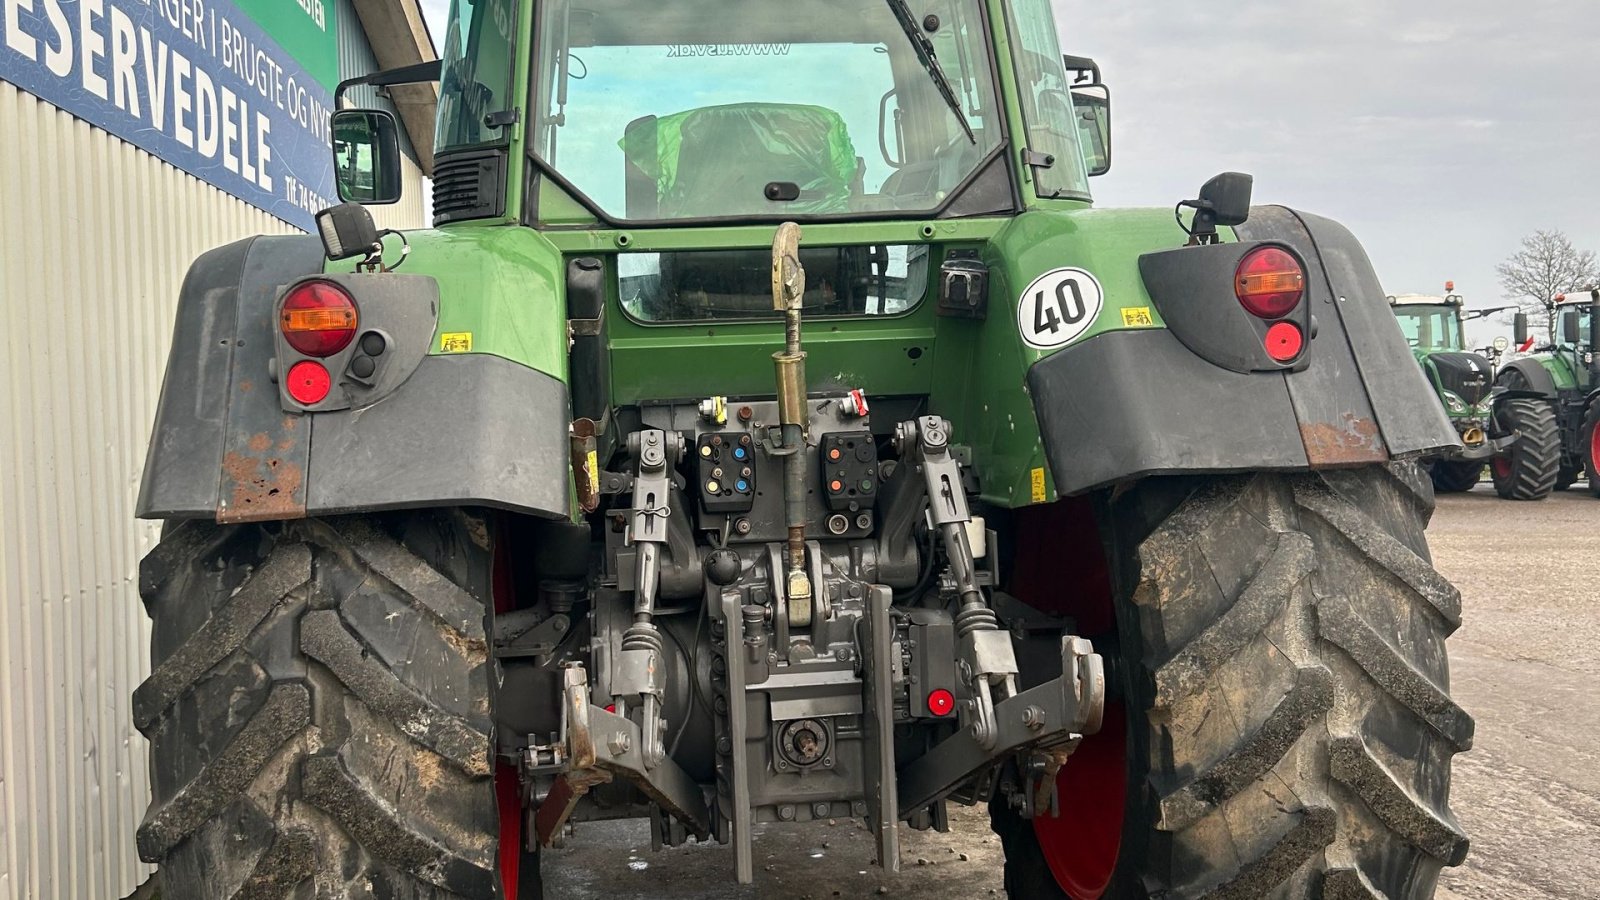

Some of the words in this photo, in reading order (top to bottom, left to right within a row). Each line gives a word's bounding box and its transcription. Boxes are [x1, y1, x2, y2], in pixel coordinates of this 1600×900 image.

[143, 0, 206, 50] GER
[211, 7, 216, 57] I
[222, 17, 284, 110] BRUGTE
[287, 77, 307, 129] OG
[310, 94, 332, 149] NYE
[285, 175, 298, 207] Tlf.
[299, 183, 308, 211] 74
[1034, 278, 1086, 335] 40
